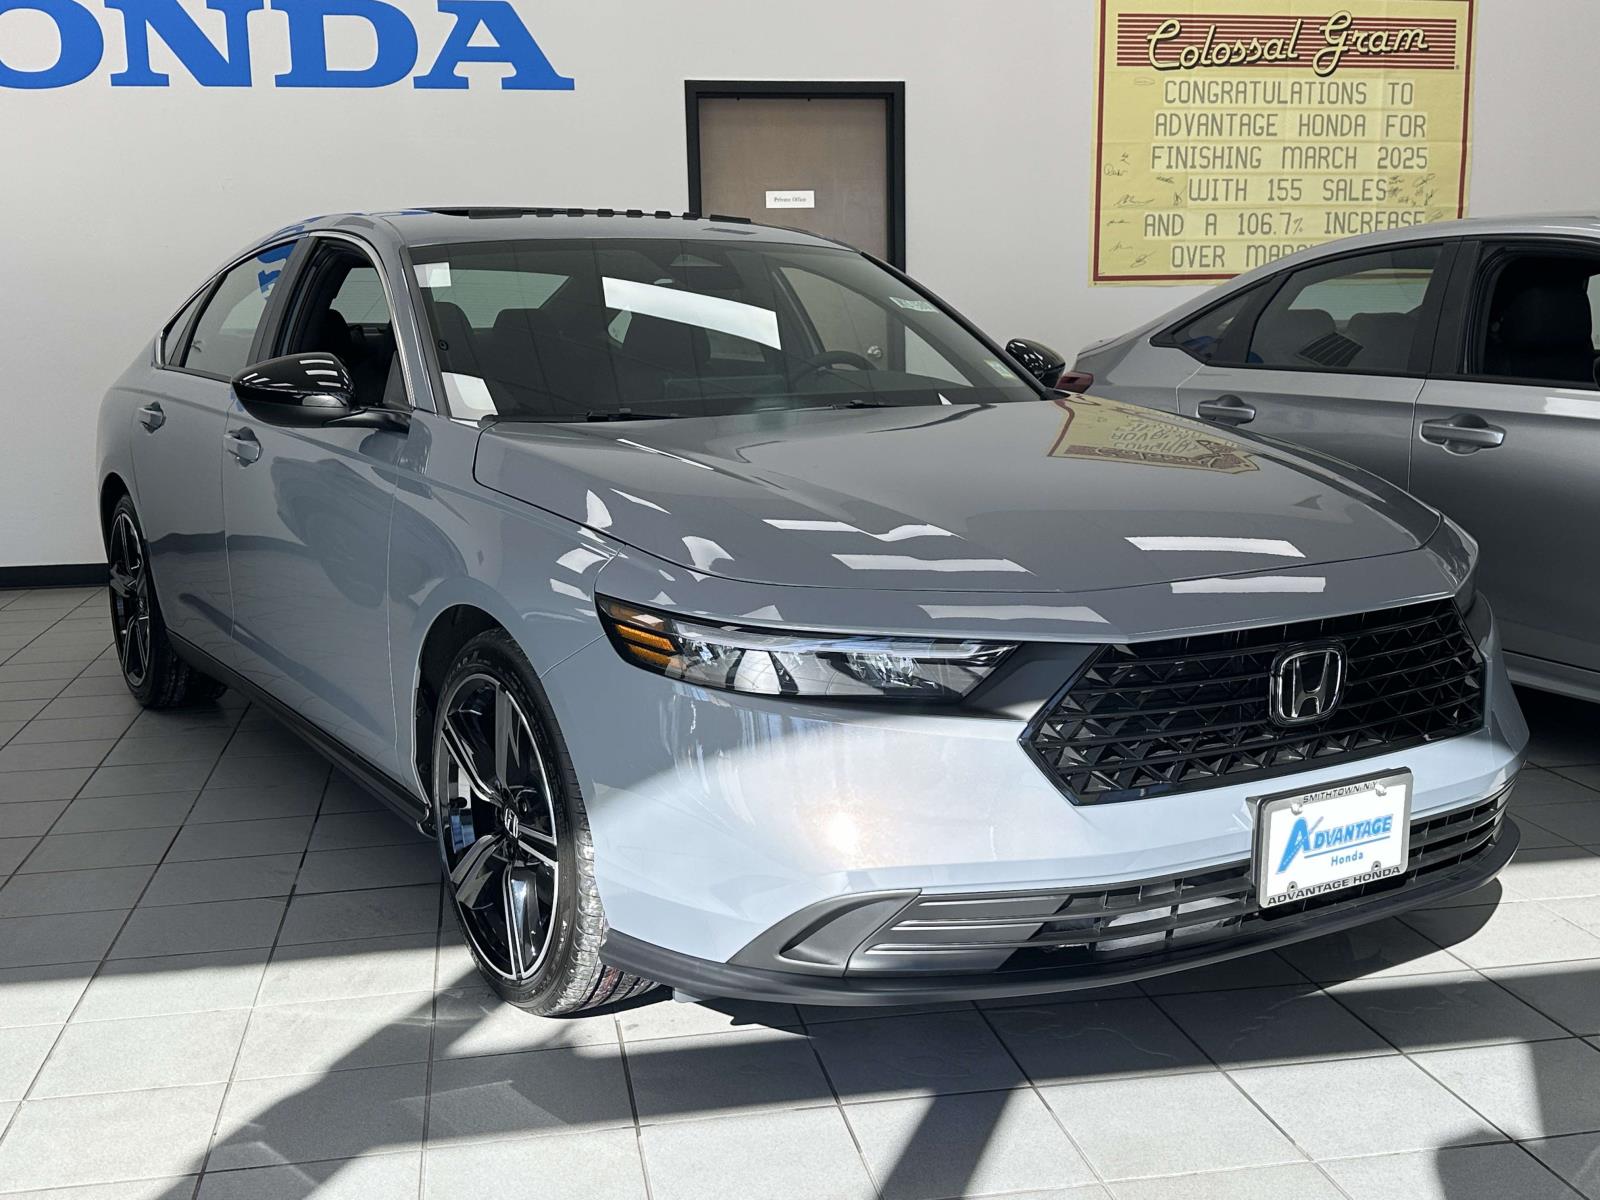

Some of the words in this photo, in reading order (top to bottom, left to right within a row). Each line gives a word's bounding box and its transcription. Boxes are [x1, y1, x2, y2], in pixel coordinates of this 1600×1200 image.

[1146, 18, 1304, 70] Colossal
[1312, 10, 1430, 77] Gram
[1164, 80, 1368, 105] CONGRATULATIONS
[1388, 82, 1414, 106] TO
[1155, 112, 1279, 137] ADVANTAGE
[1298, 113, 1367, 137] HONDA
[1385, 114, 1427, 138] FOR
[1151, 145, 1262, 169] FINISHING
[1281, 146, 1358, 169] MARCH
[1377, 146, 1428, 170] 2025
[1188, 178, 1248, 202] WITH
[1267, 178, 1303, 202] 155
[1323, 178, 1387, 202] SALES
[1144, 213, 1185, 237] AND
[1205, 213, 1218, 236] A
[1238, 212, 1304, 236] 106.7%
[1324, 211, 1425, 235] INCREASE
[1171, 245, 1226, 269] OVER
[1276, 813, 1394, 875] ADVANTAGE
[1330, 850, 1364, 867] Honda
[1267, 879, 1350, 906] ADVANTAGE
[1353, 866, 1401, 884] HONDA
